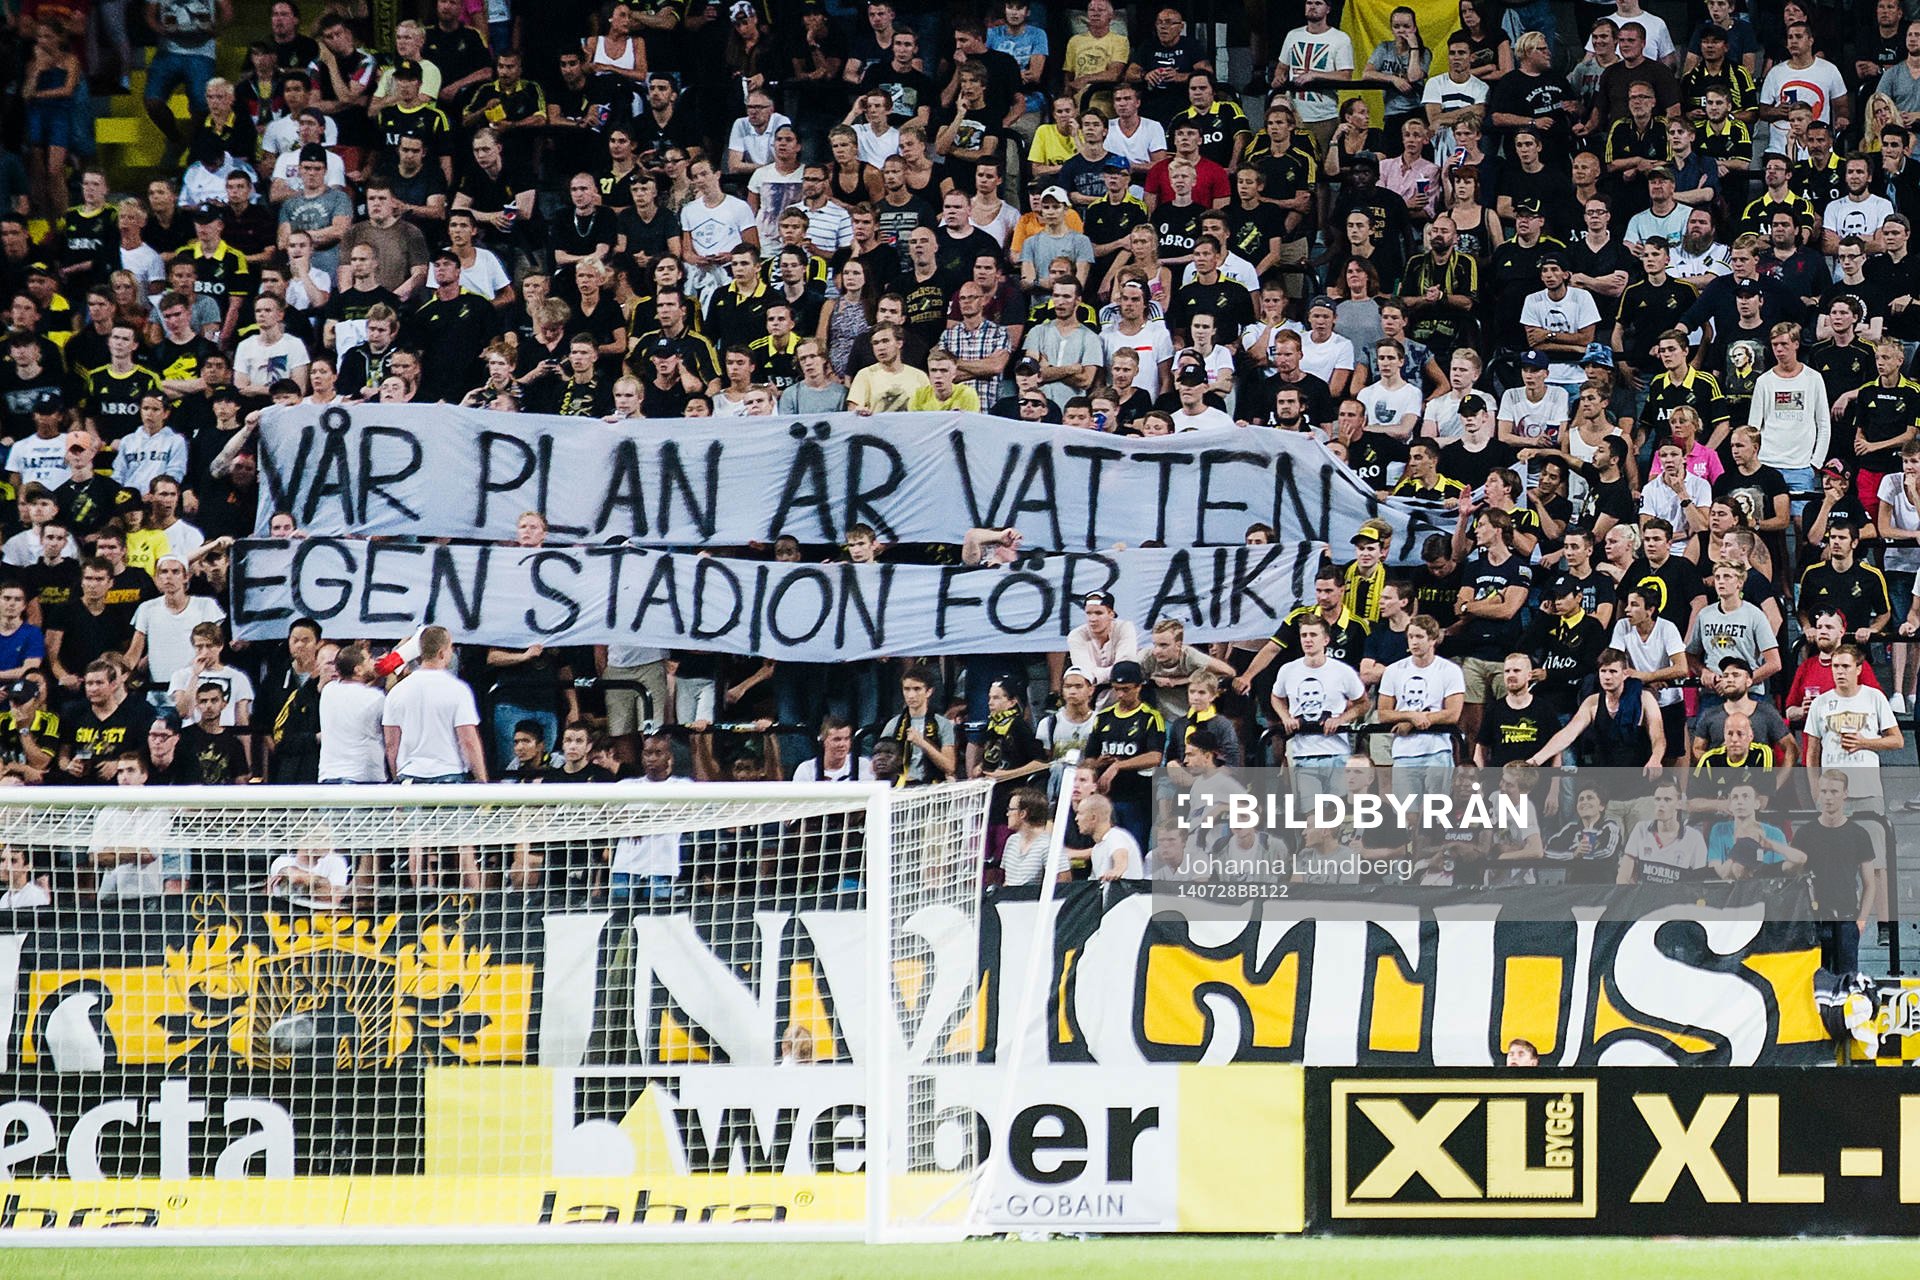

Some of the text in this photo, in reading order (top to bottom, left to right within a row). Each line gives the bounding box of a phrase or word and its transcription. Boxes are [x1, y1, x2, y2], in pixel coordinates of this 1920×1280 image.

[192, 281, 226, 295] BRO
[258, 406, 1400, 554] VÅR PLAN ÄR VATTEN
[232, 537, 1312, 652] EGEN STADION FÖR AIK!
[1703, 624, 1747, 639] GNAGET
[1643, 863, 1680, 881] MORRIS
[541, 893, 1768, 1067] INVICTUS
[671, 1074, 1159, 1184] weber
[1350, 1099, 1574, 1199] XL BYGG
[1630, 1093, 1920, 1204] XL-
